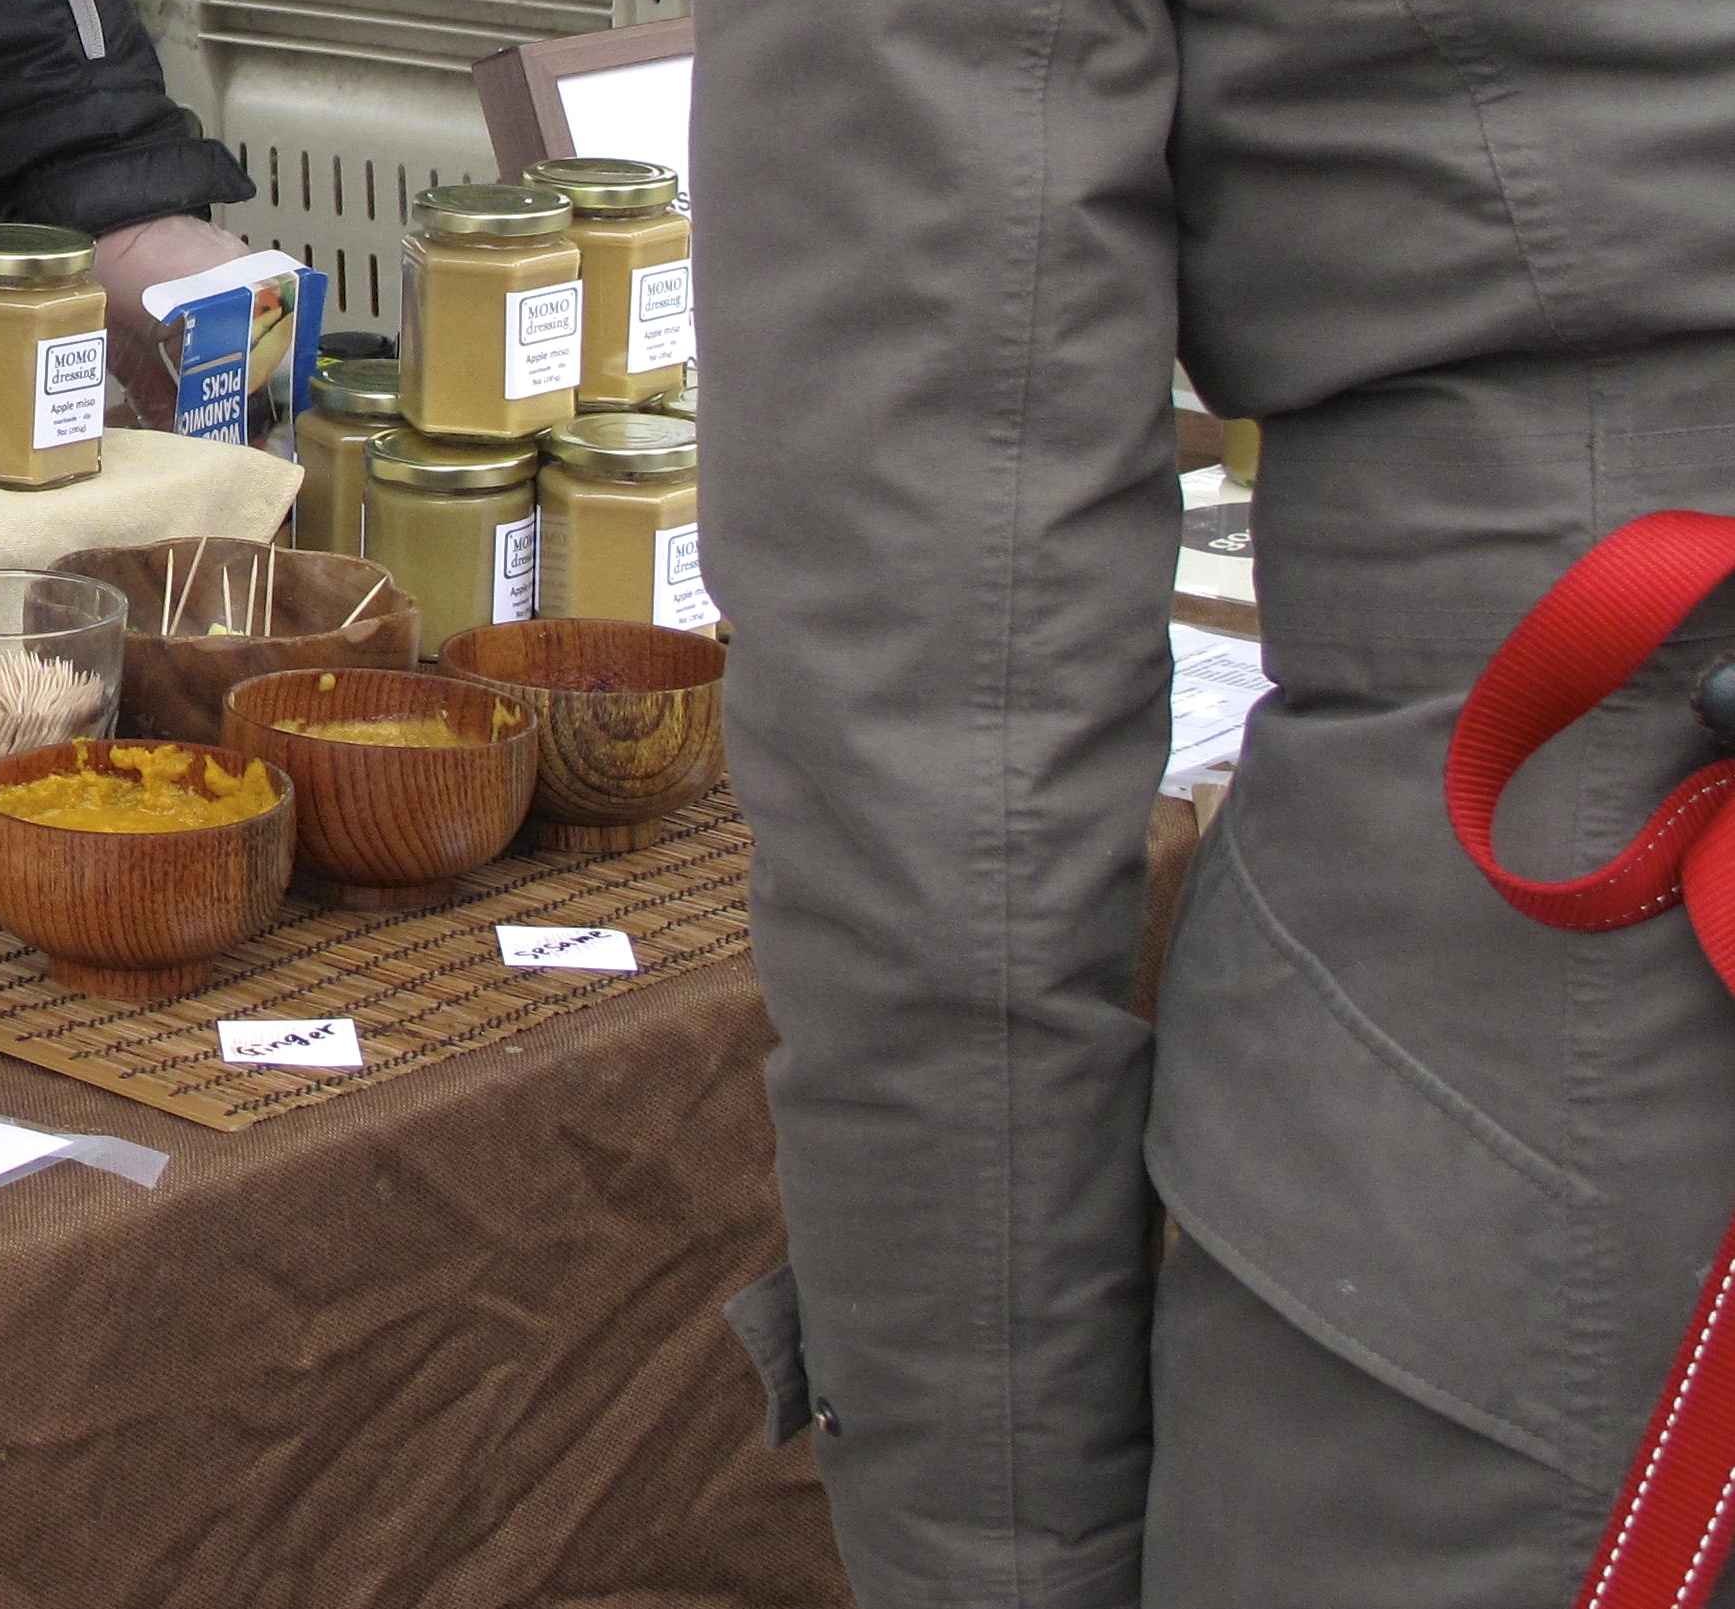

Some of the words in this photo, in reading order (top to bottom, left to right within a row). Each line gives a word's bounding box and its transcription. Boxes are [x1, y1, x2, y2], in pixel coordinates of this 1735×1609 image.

[647, 277, 682, 296] MOMO
[528, 299, 570, 320] MOMO
[645, 295, 681, 311] dressing
[526, 317, 570, 335] dressing
[54, 348, 97, 368] MOMO
[52, 366, 96, 385] dressing
[202, 368, 242, 401] PICKS
[50, 401, 74, 415] Apple
[76, 398, 95, 409] miso
[236, 1023, 335, 1056] Ginger
